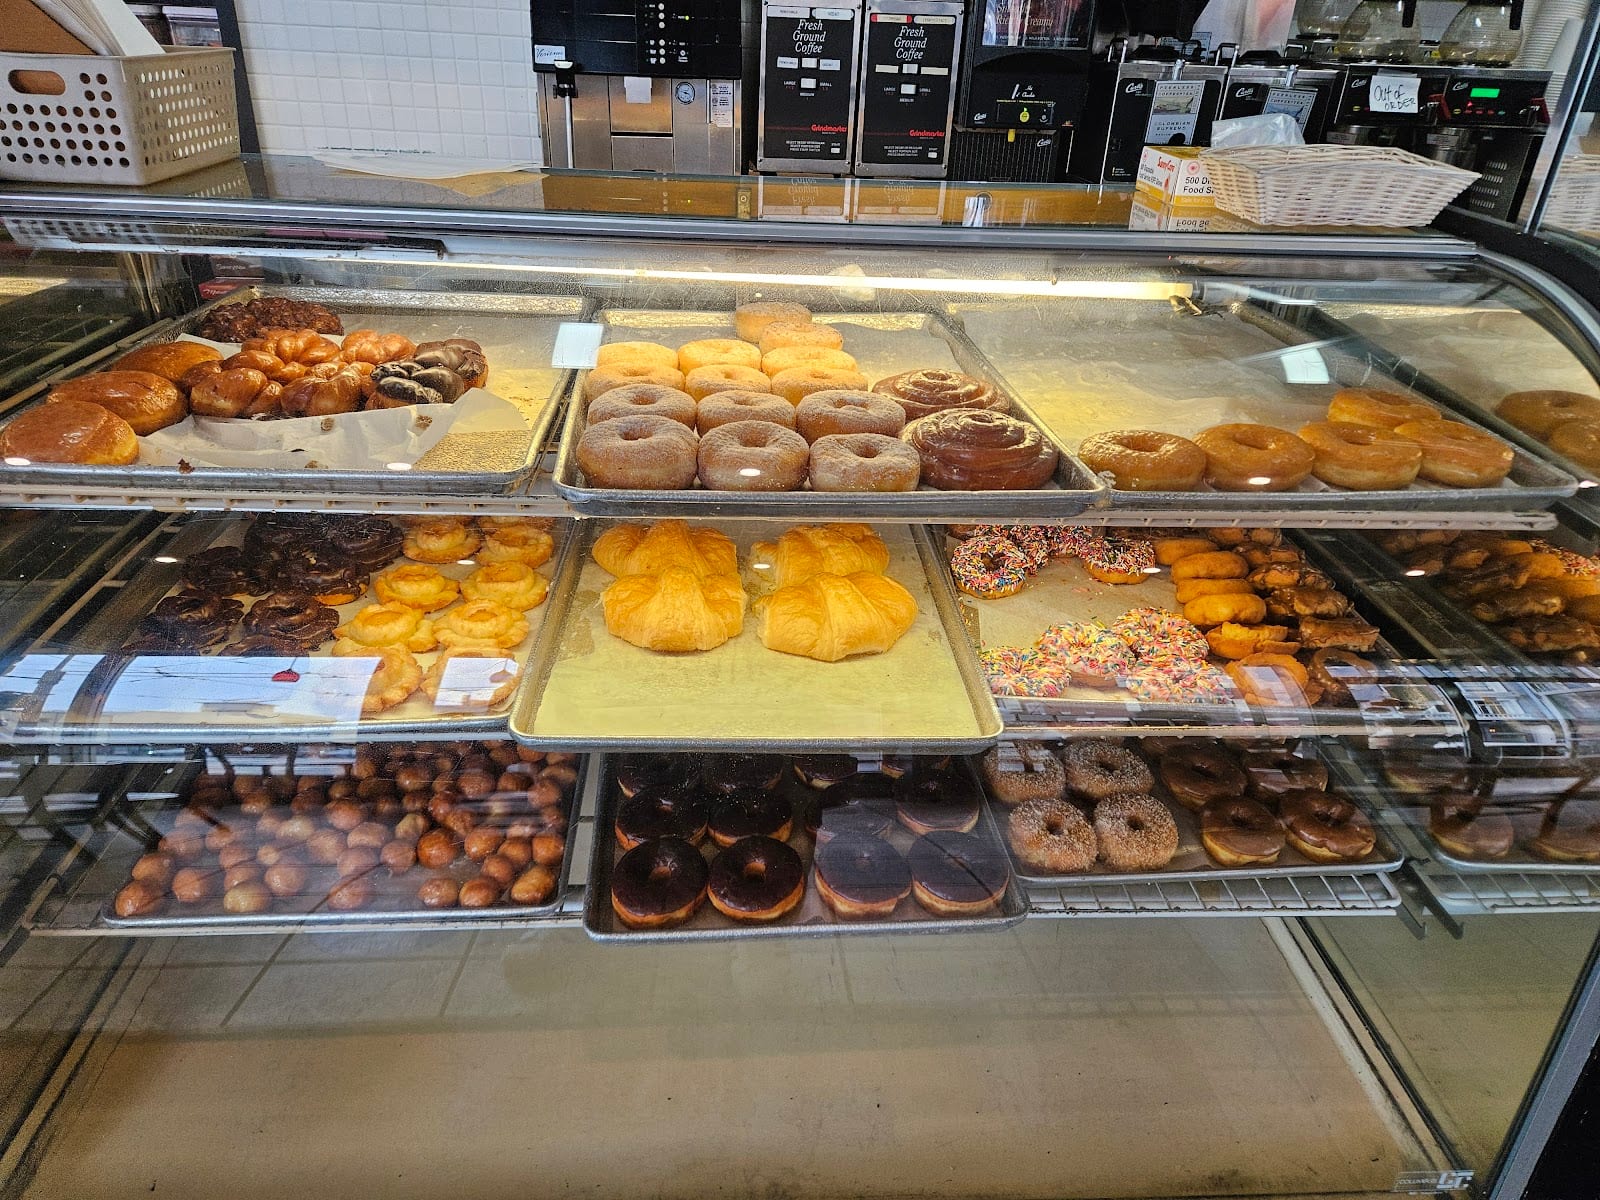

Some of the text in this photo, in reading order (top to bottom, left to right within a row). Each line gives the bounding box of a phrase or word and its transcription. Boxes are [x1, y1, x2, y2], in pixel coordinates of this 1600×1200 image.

[797, 19, 823, 31] Fresh
[899, 25, 925, 37] Fresh
[792, 30, 827, 42] Ground
[795, 41, 823, 55] Coffee
[894, 37, 927, 49] Ground
[896, 48, 924, 61] Coffee
[1374, 85, 1392, 102] Out
[1384, 97, 1416, 111] ORDER
[811, 124, 847, 132] Grindmaster
[909, 129, 945, 137] Grindmaster
[1185, 176, 1200, 185] 500
[1183, 185, 1204, 194] Food
